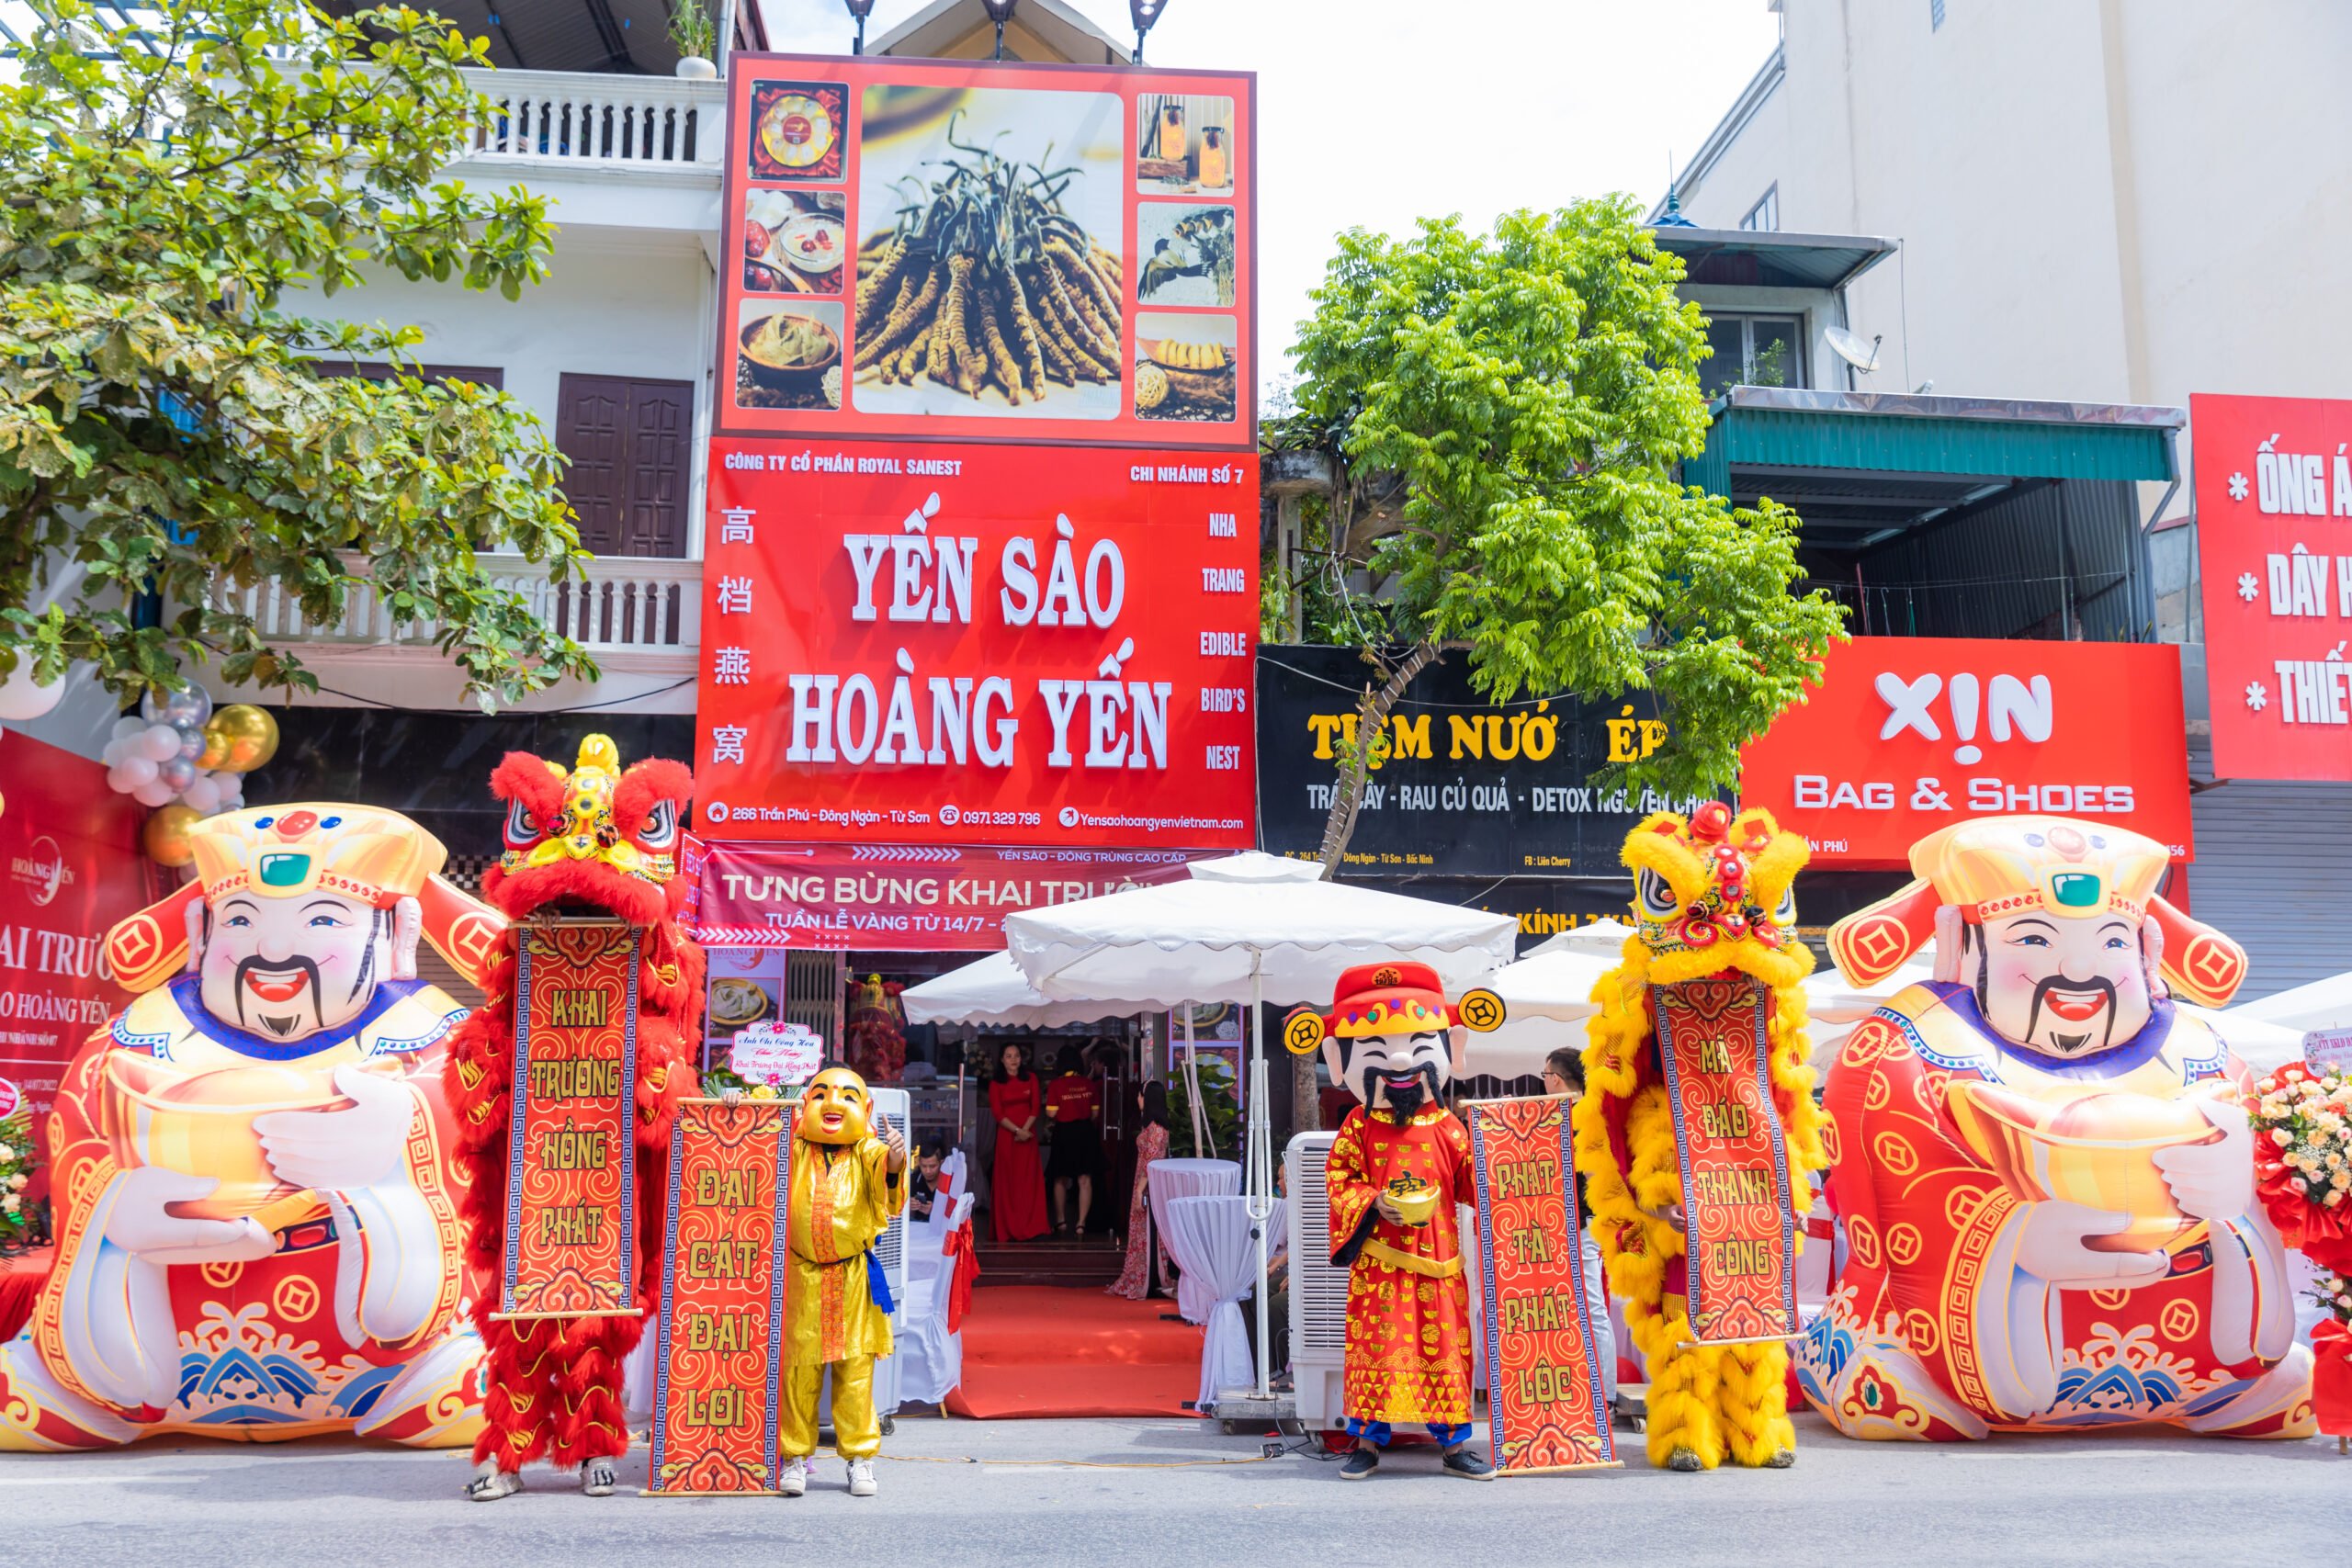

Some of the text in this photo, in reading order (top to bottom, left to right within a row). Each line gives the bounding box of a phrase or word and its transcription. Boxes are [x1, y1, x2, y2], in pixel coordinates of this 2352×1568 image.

[725, 450, 962, 476] CÔNG TY CỔ PHẦN ROYAL SANEST
[1130, 463, 1244, 483] CHI NHÁNH SỐ 7
[2256, 433, 2326, 516] ỐNG
[1209, 513, 1237, 537] NHA
[843, 491, 1125, 628] YẾN SÀO
[1202, 568, 1245, 592] TRANG
[2267, 542, 2329, 617] DÂY
[711, 505, 757, 765] 高档燕窝
[1200, 631, 1246, 657] EDIBLE
[786, 637, 1171, 770] HOÀNG YẾN
[1206, 745, 1240, 770] NEST
[1306, 779, 1356, 810] TRÁ
[1400, 785, 1436, 811] RAU
[1442, 777, 1466, 811] CỦ
[1472, 777, 1510, 812] QUẢ
[1532, 787, 1592, 813] DETOX
[1793, 774, 2135, 813] BAG & SHOES
[732, 807, 757, 820] 266
[759, 807, 785, 821] Trần
[786, 808, 808, 822] Phú
[819, 808, 849, 827] Đông
[851, 809, 880, 827] Ngàn
[889, 809, 907, 823] Từ
[910, 811, 930, 823] Sơn
[963, 812, 1040, 825] 0971 329 796
[1080, 813, 1243, 831] Yensaohoangyenvietnam.com
[997, 850, 1021, 861] YẾN
[1023, 850, 1048, 862] SÀO
[1057, 851, 1091, 863] ĐÔNG
[1093, 851, 1134, 863] TRÙNG
[1135, 853, 1160, 863] CAO
[1162, 851, 1186, 863] CẤP
[1419, 854, 1433, 864] Ninh
[1524, 855, 1532, 865] FB
[1551, 856, 1571, 867] Cherry
[1823, 838, 1848, 852] PHÚ
[2165, 844, 2185, 856] 56
[722, 874, 825, 903] TƯNG
[834, 872, 939, 905] BỪNG
[947, 879, 1032, 907] KHAI
[765, 908, 822, 930] TUẦN
[824, 908, 849, 931] LỄ
[852, 911, 910, 931] VÀNG
[912, 910, 940, 931] TỪ
[944, 916, 985, 933] 14/7
[1517, 908, 1577, 934] KÍNH
[17, 989, 77, 1022] HOÀNG
[80, 994, 111, 1024] YẾN
[551, 989, 607, 1028] KHAI
[1700, 1032, 1733, 1075] MÃ
[532, 1055, 620, 1102] TRƯƠNG
[1702, 1097, 1750, 1139] ĐÁO
[541, 1116, 606, 1170] HỒNG
[695, 1168, 757, 1213] ĐẠI
[1496, 1152, 1555, 1200] PHÁT
[1698, 1164, 1772, 1206] THÀNH
[540, 1204, 603, 1247] PHÁT
[1511, 1223, 1553, 1265] TÀI
[689, 1237, 759, 1280] CÁT
[1713, 1233, 1770, 1277] CÔNG
[1504, 1288, 1571, 1335] PHÁT
[688, 1313, 750, 1359] ĐẠI
[1518, 1359, 1572, 1411] LỘC
[686, 1387, 744, 1436] LỢI
